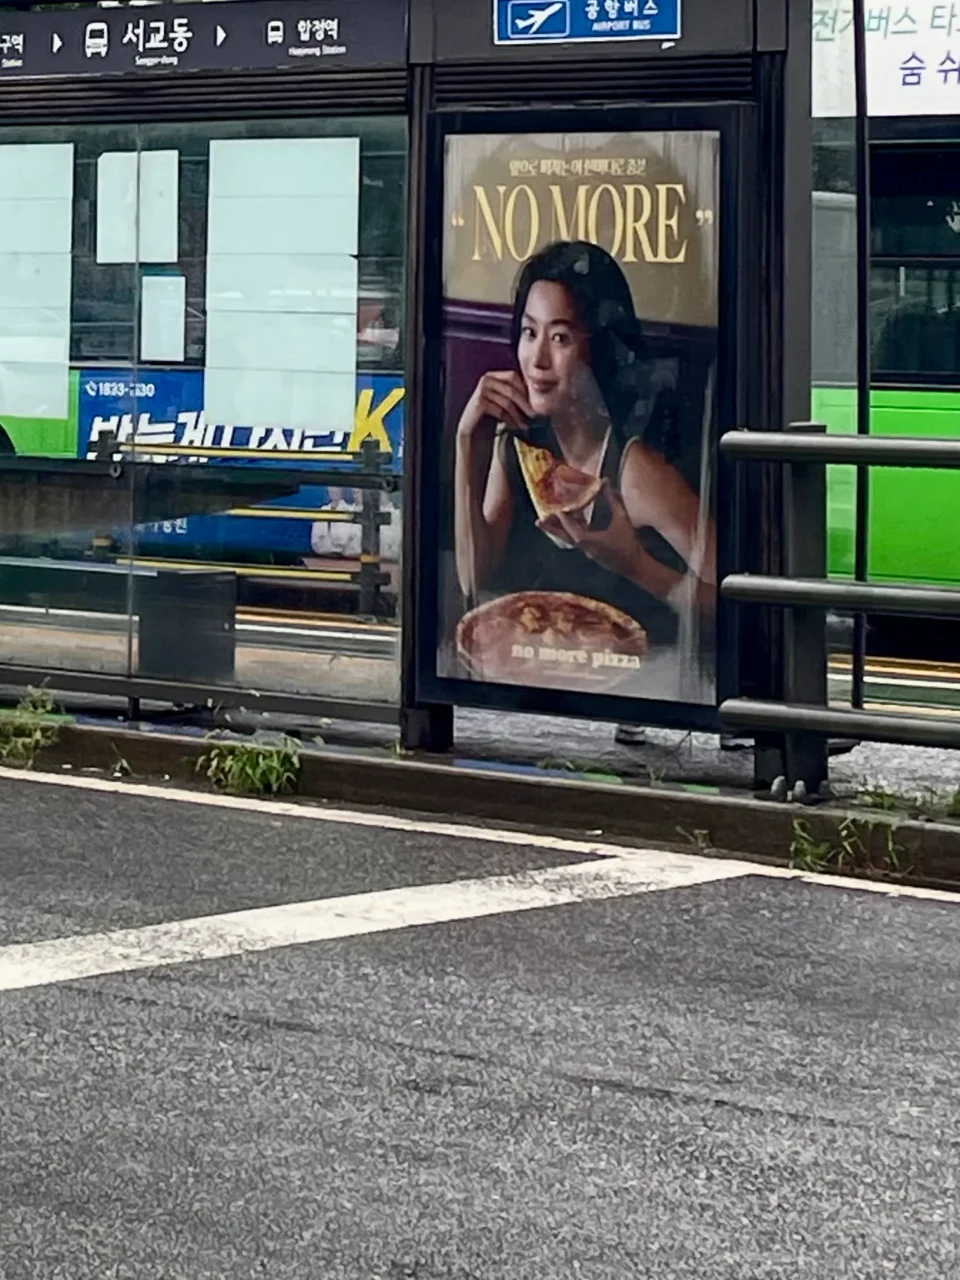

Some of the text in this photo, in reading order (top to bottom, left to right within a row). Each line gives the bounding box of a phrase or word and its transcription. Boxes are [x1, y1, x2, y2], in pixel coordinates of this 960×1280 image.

[122, 18, 192, 52] 서교동
[297, 18, 338, 41] 합정역
[930, 3, 960, 37] 타
[899, 51, 926, 86] 숨
[472, 184, 687, 263] NO MORE
[347, 388, 406, 452] K
